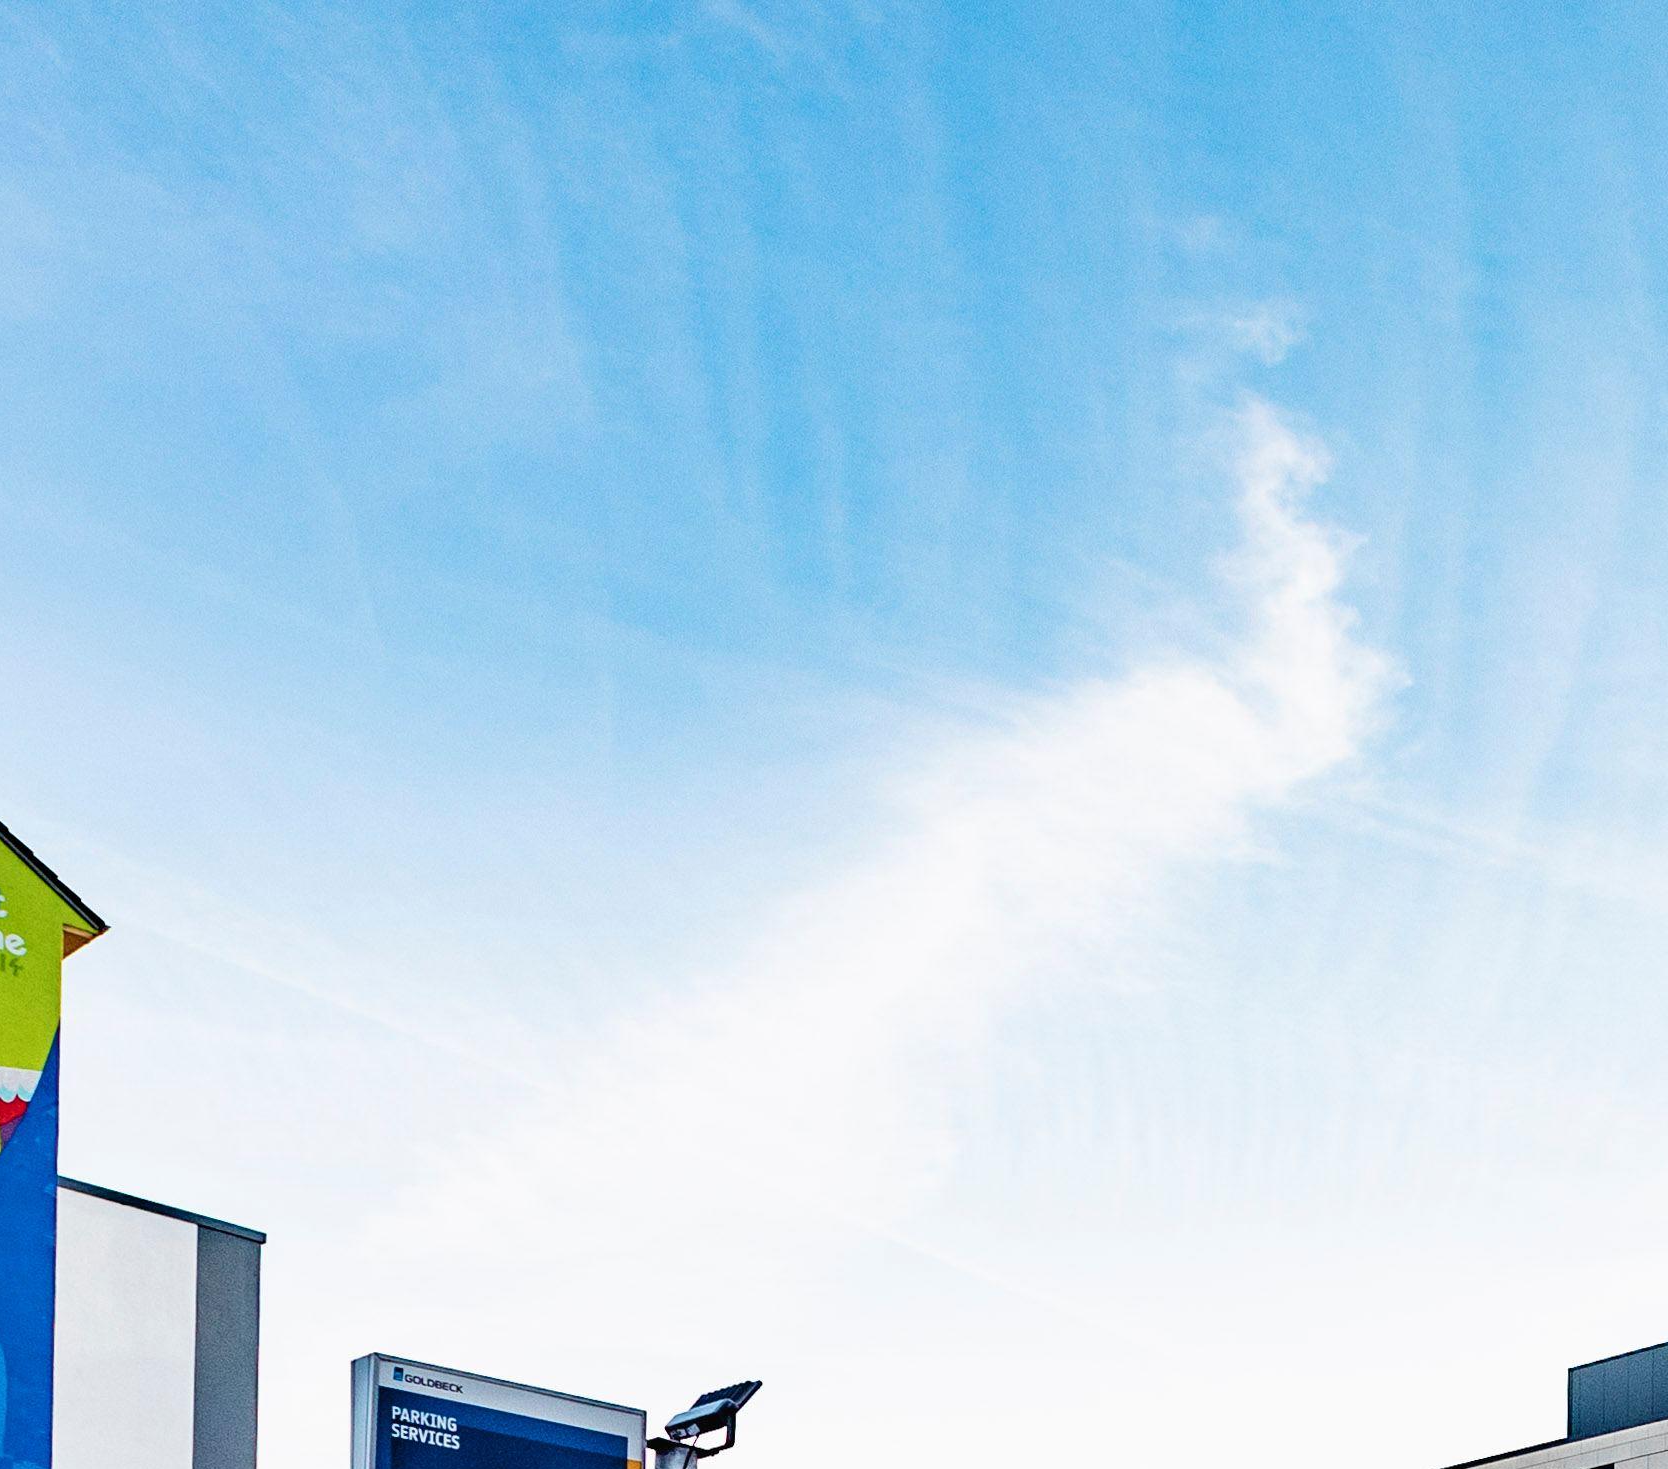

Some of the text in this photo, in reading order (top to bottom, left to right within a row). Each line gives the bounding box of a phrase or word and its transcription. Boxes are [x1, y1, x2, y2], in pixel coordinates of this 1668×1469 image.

[404, 1374, 463, 1394] GOLDBECK
[392, 1405, 458, 1432] PARKING
[391, 1423, 461, 1450] SERVICES
